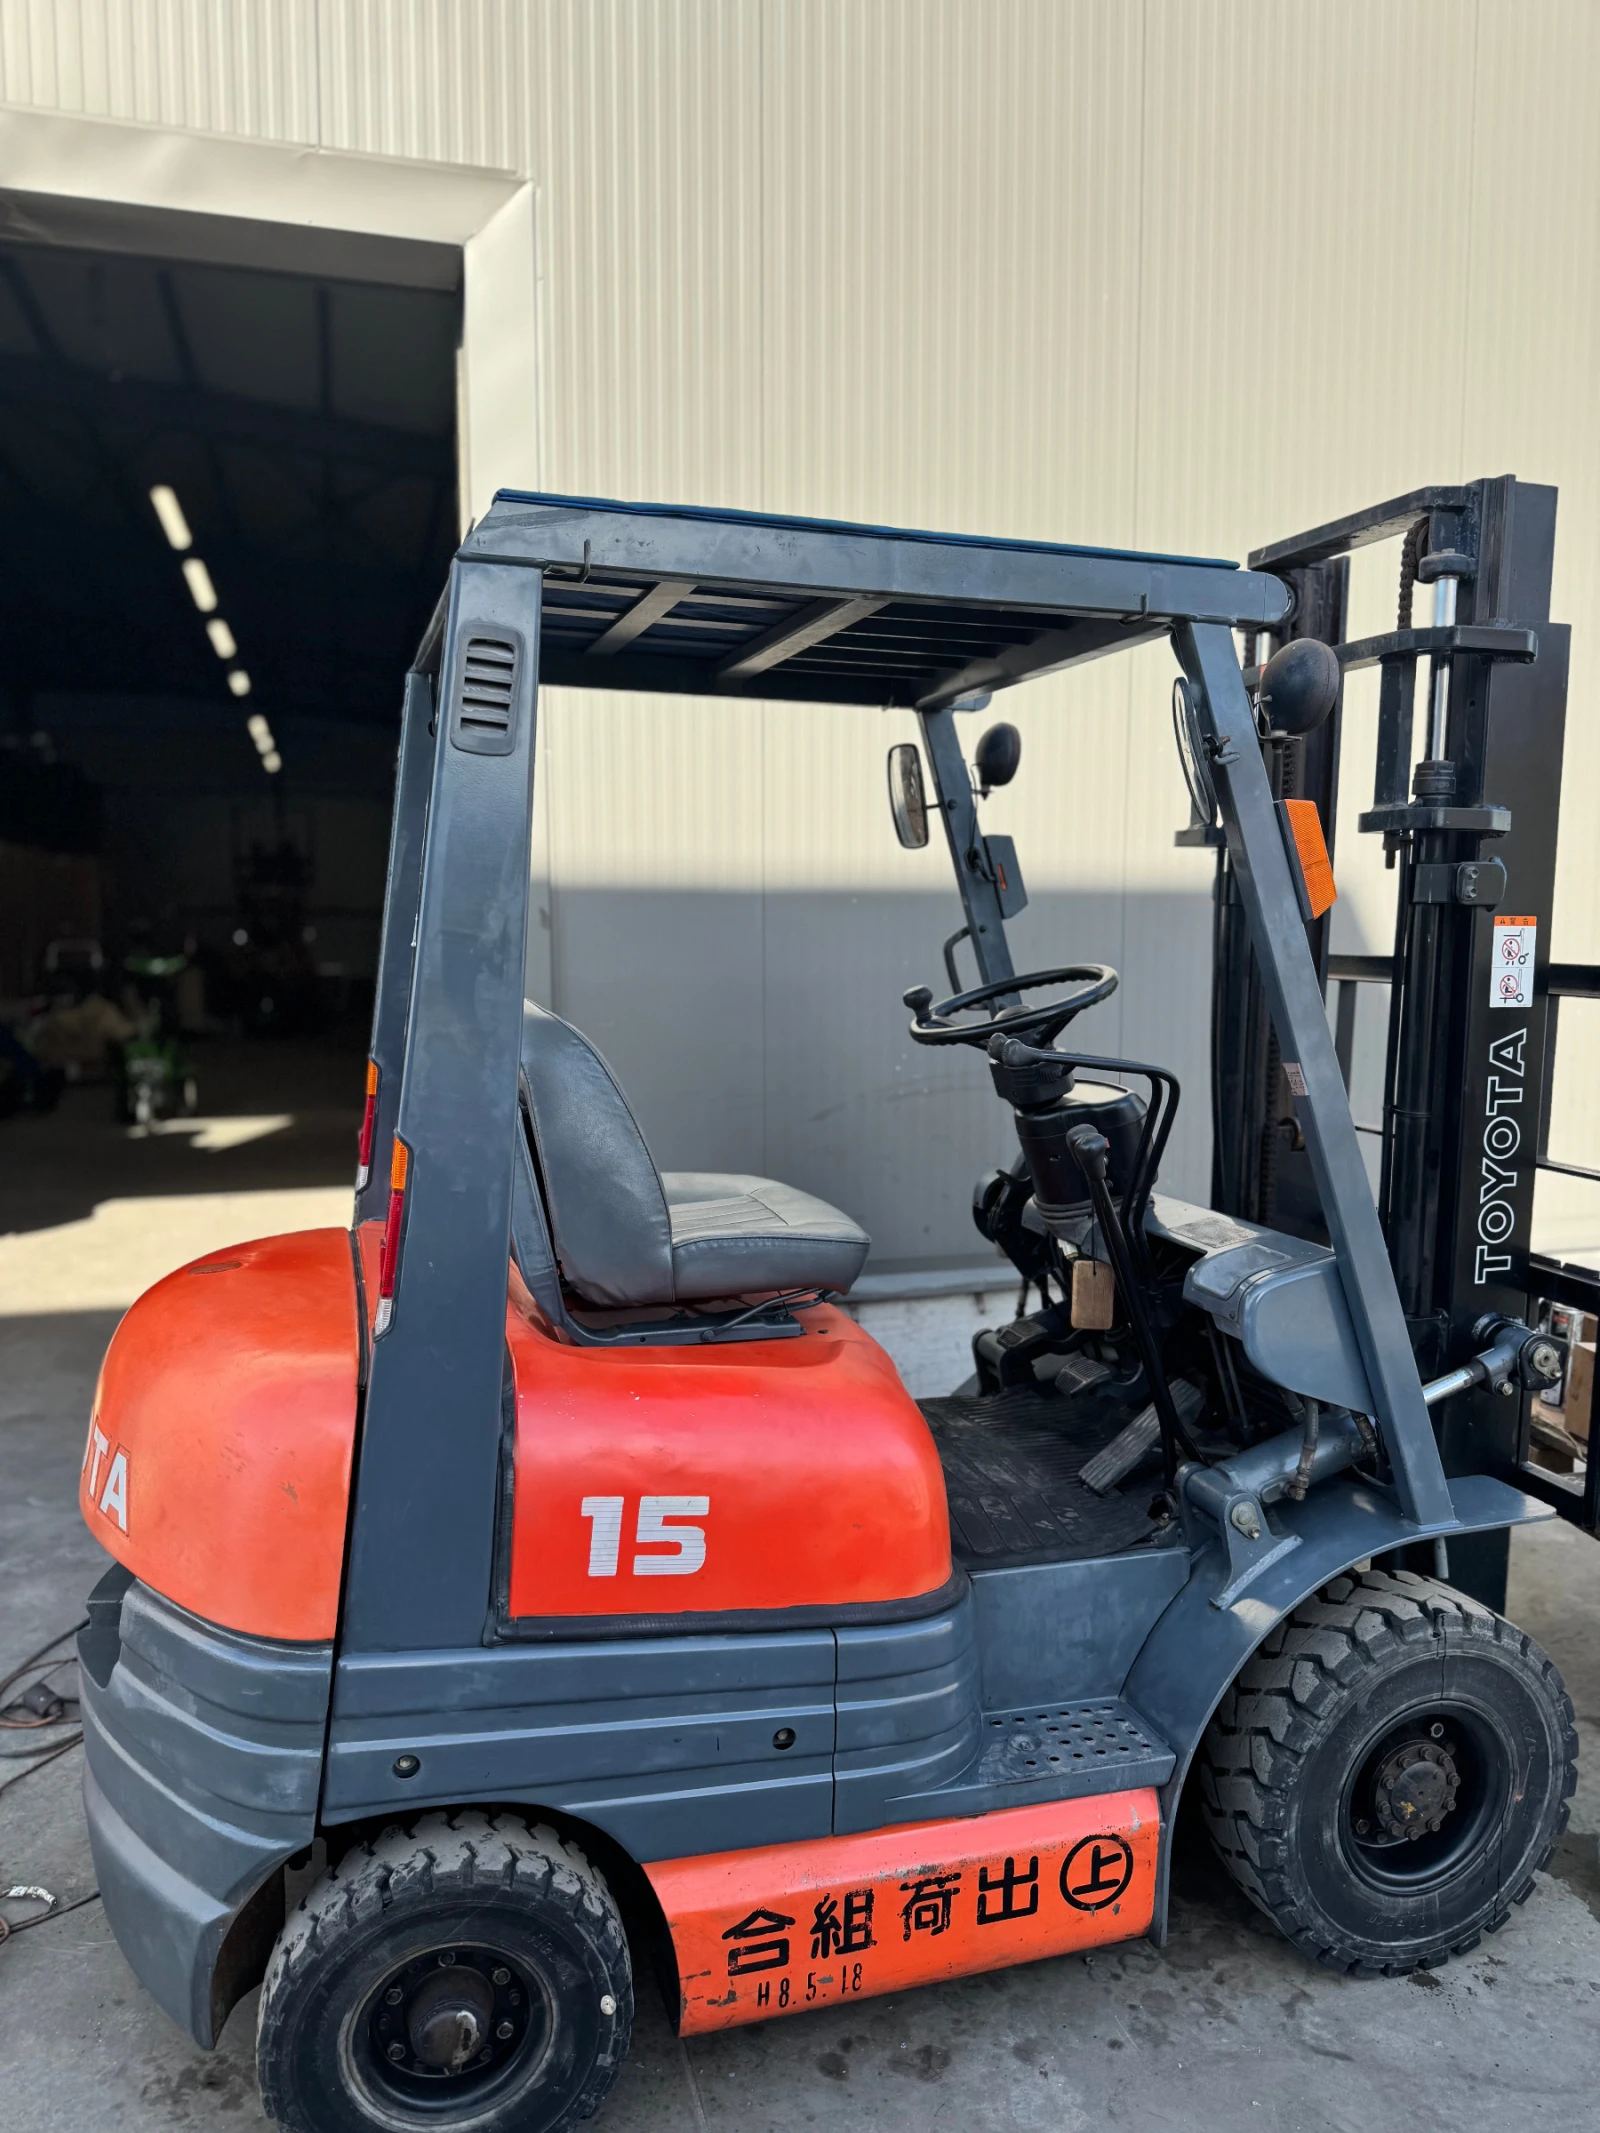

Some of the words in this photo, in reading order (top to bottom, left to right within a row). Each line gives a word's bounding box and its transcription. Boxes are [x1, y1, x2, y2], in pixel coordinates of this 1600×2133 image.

[1475, 1028, 1527, 1284] TOYOTA
[82, 1410, 127, 1532] TA
[581, 1496, 710, 1576] 15
